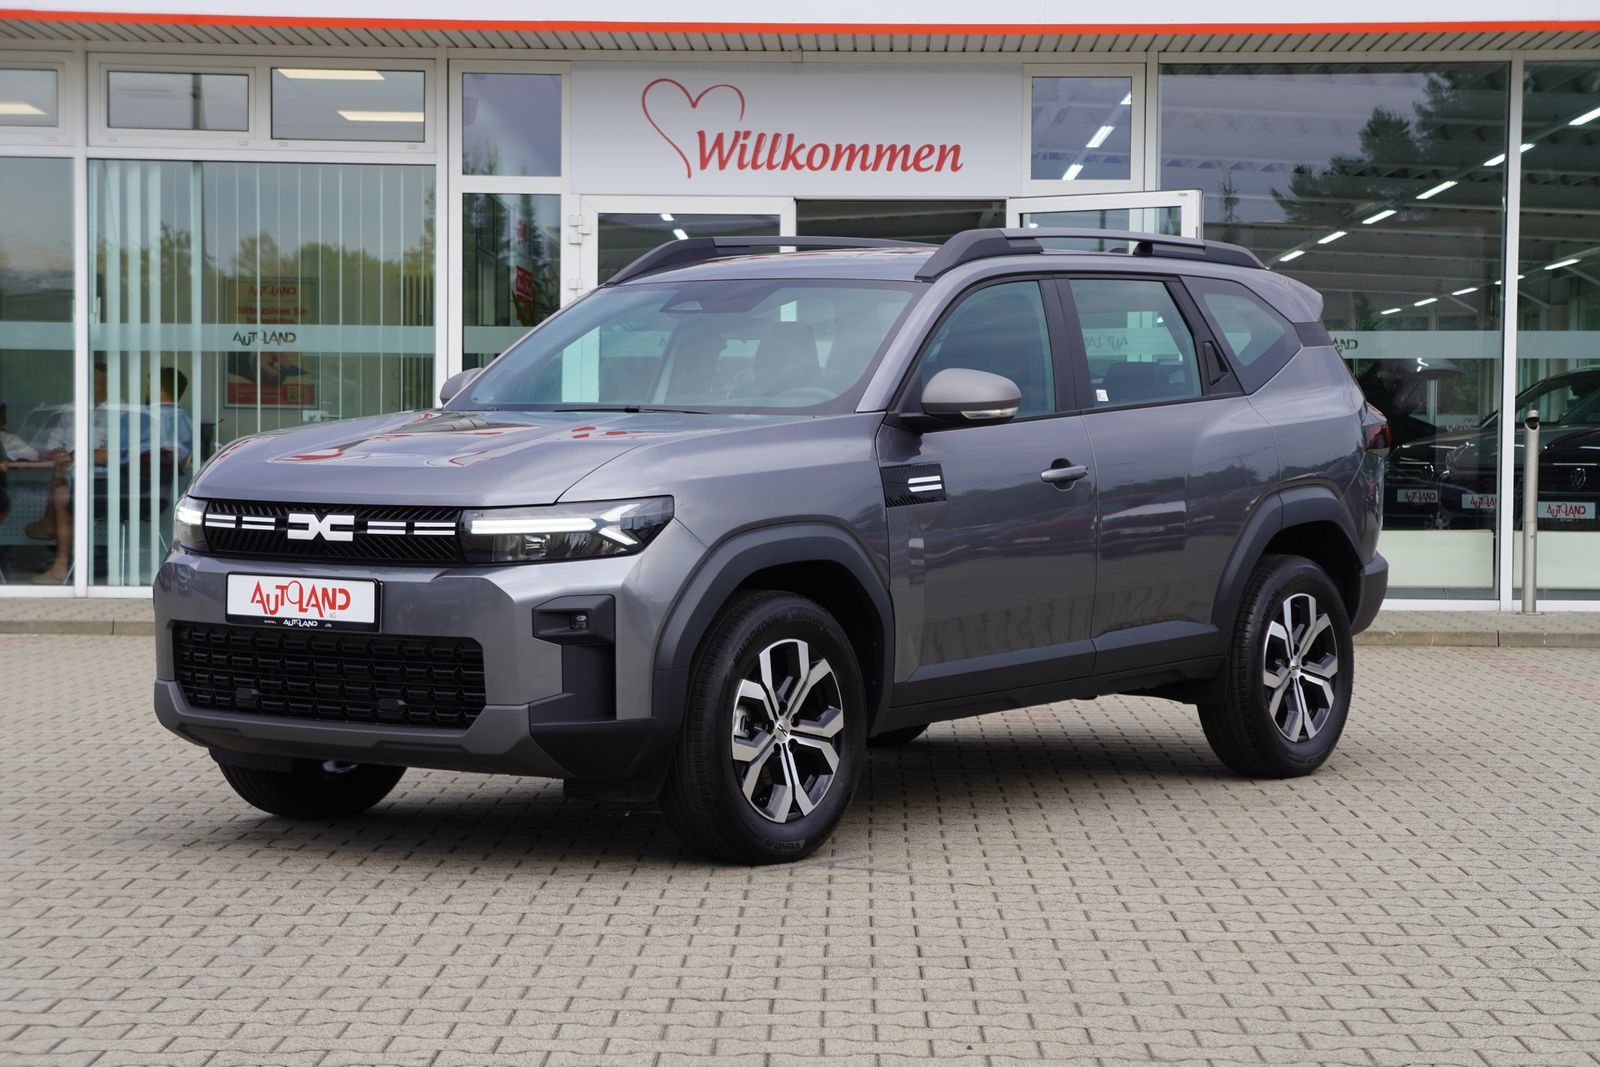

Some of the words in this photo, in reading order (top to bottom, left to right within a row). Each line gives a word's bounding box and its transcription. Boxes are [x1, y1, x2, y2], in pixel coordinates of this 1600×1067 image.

[697, 130, 964, 172] Willkommen
[248, 285, 297, 298] ATOLAND
[1547, 503, 1587, 519] AUTOLAND
[250, 580, 351, 618] AUTOLAND
[283, 619, 318, 628] AUTOLAND
